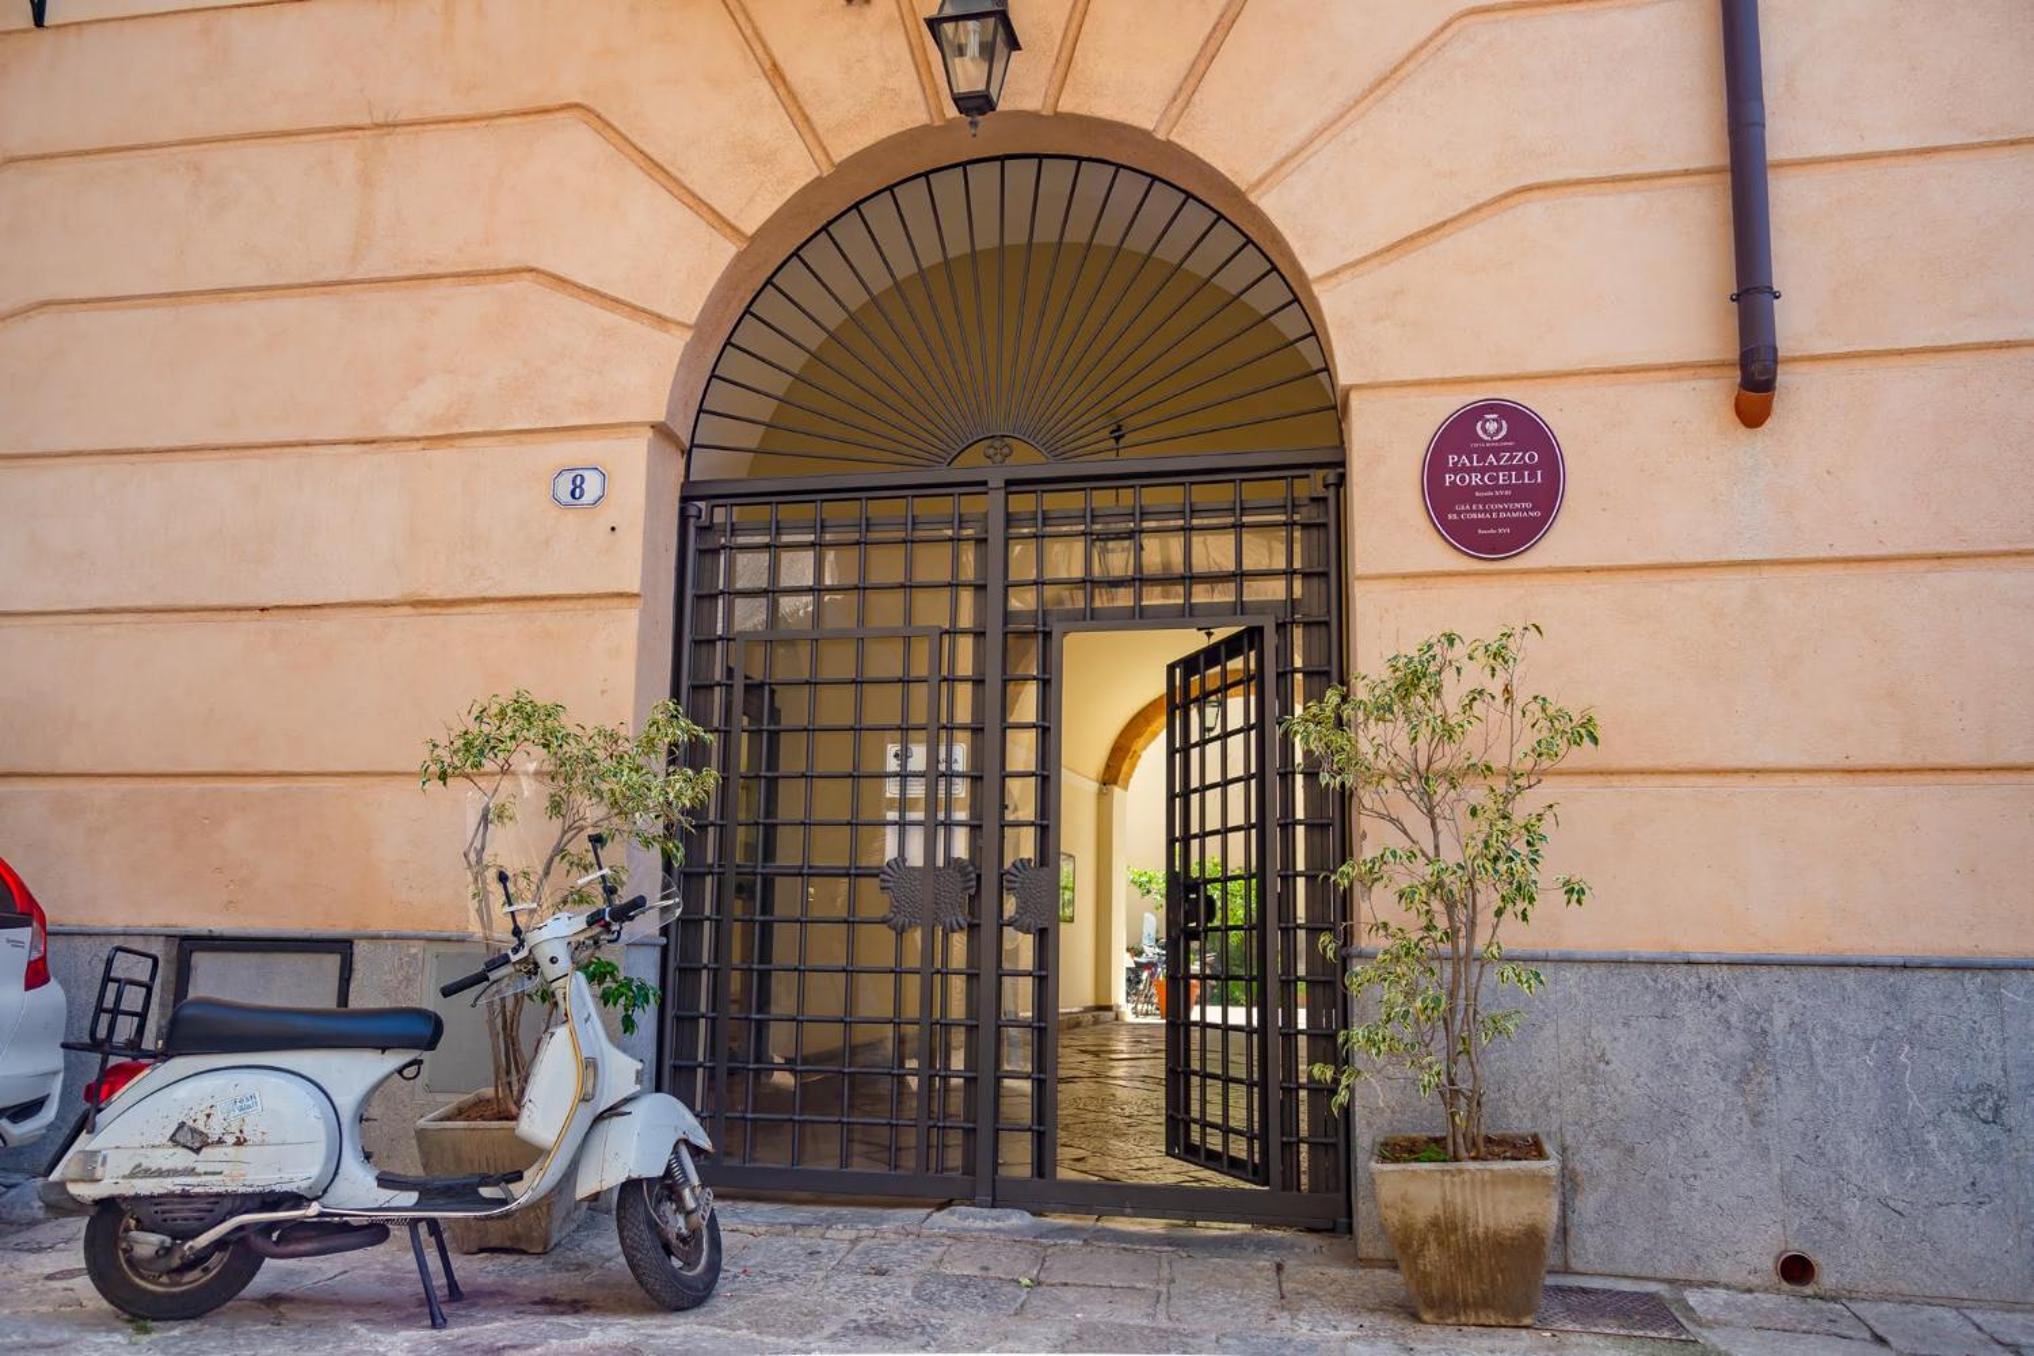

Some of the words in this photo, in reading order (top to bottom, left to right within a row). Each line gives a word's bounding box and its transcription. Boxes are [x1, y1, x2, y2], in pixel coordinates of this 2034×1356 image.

[1448, 451, 1539, 467] PALAZZO
[1444, 470, 1542, 487] PORCELLI
[570, 474, 585, 500] 8
[1472, 503, 1484, 511] EX
[1485, 502, 1533, 510] CONVENTO
[1461, 512, 1491, 520] COSMA
